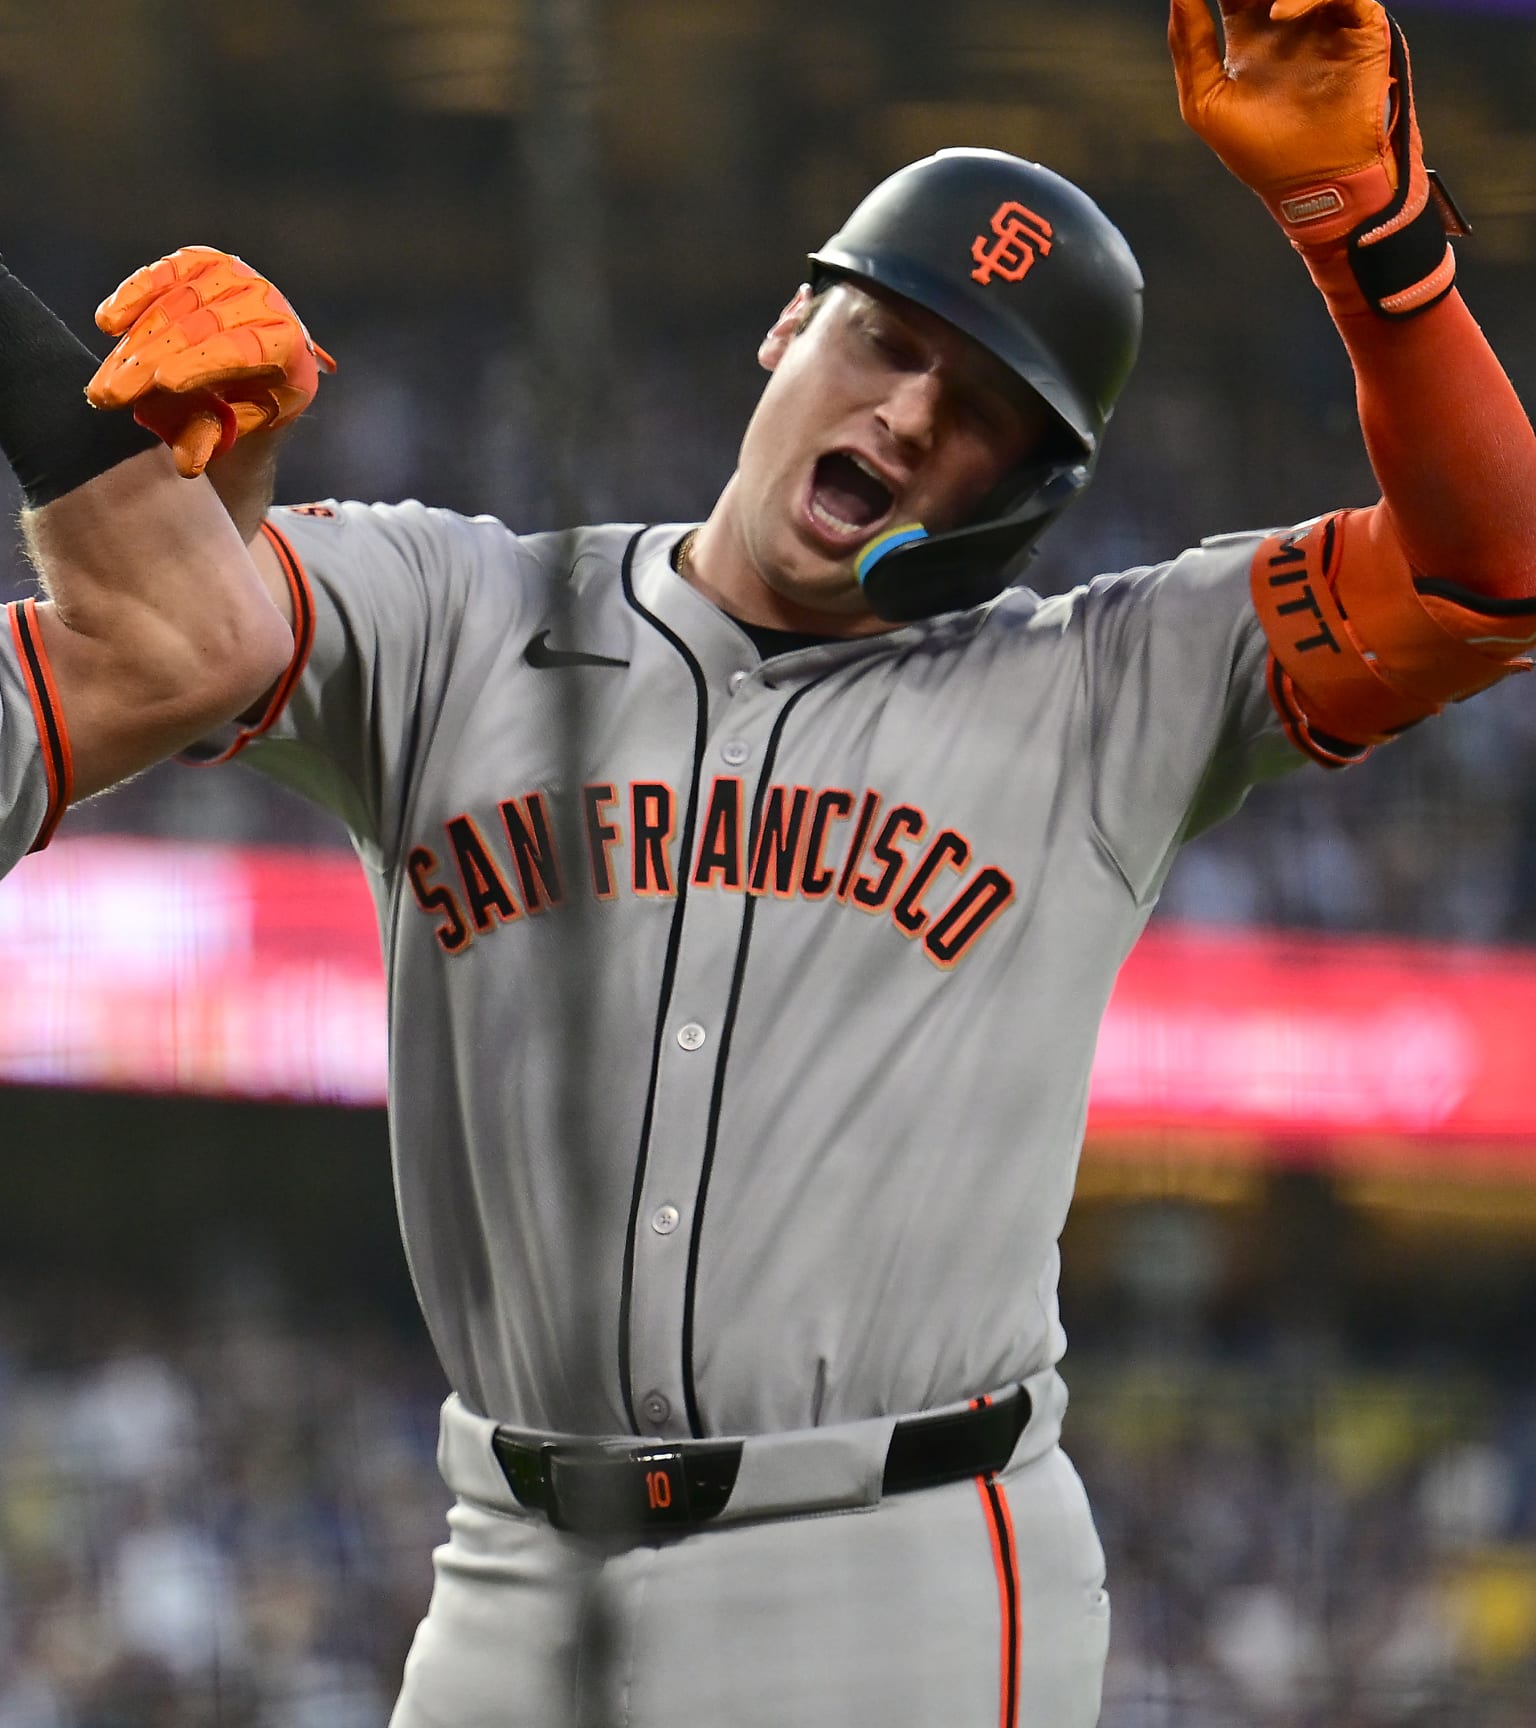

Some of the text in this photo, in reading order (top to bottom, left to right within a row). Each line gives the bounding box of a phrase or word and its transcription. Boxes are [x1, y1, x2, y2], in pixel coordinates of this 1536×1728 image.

[1268, 537, 1342, 655] MITT
[406, 775, 1016, 971] SAN FRANCISCO
[646, 1470, 672, 1510] 10
